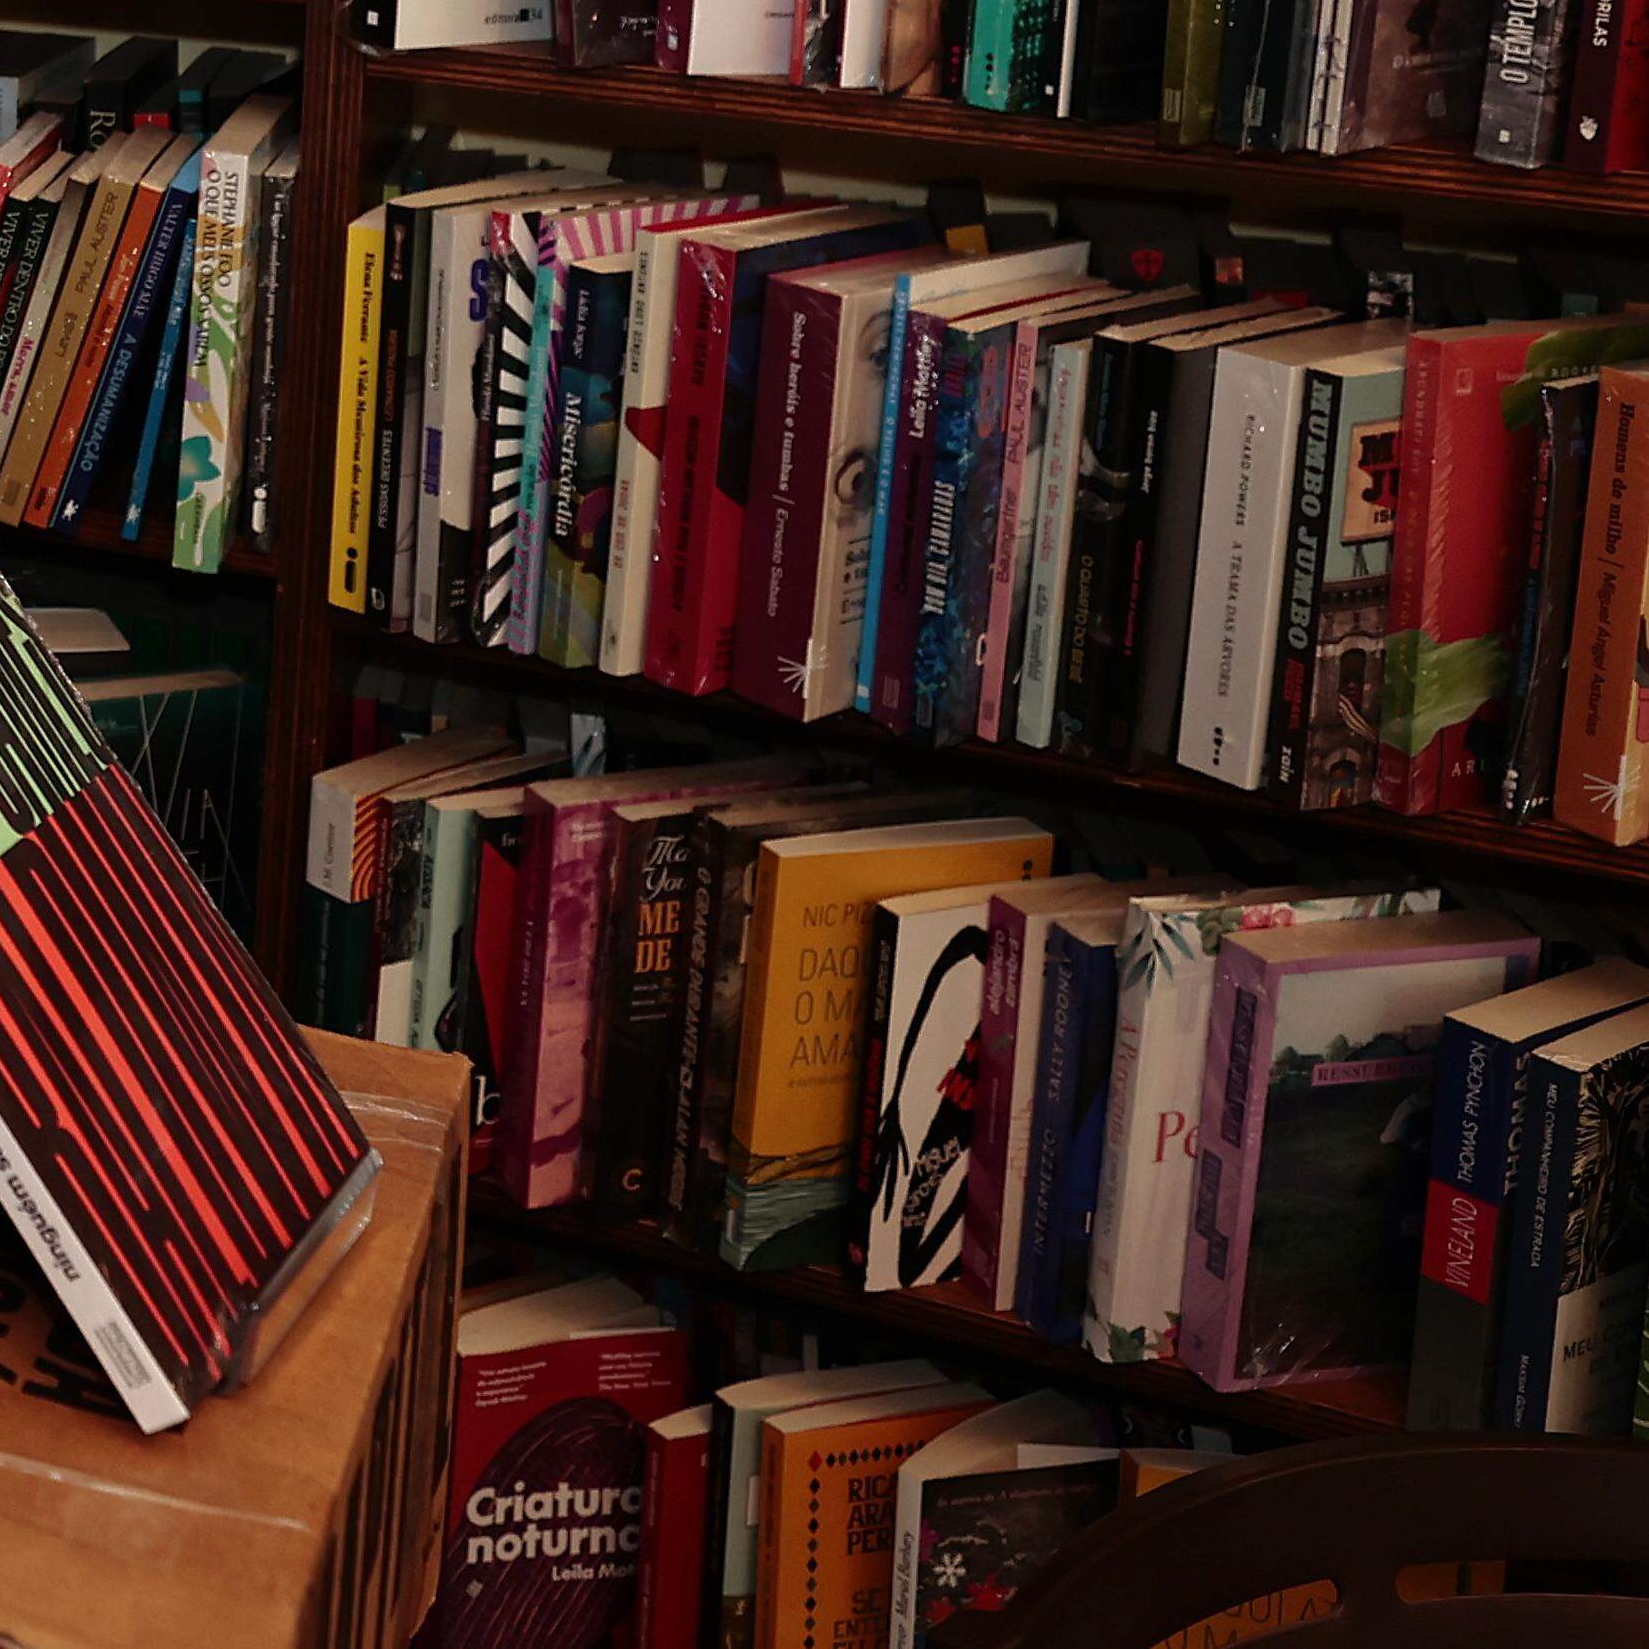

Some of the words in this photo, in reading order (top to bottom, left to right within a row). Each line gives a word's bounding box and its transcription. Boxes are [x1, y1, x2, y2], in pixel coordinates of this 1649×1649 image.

[21, 210, 50, 260] VIVER
[219, 170, 240, 252] STEPHANIE
[74, 254, 96, 297] PAUL
[92, 191, 120, 249] AUSTER
[216, 254, 232, 289] FOO
[2, 260, 35, 323] DENTRO
[789, 310, 807, 359] Sobre
[79, 348, 133, 474] DESUMANIZAÇÃO
[784, 361, 804, 415] heróis
[554, 391, 584, 537] Misericórdia
[778, 430, 796, 492] tumbas
[1300, 379, 1333, 519] MUMBO
[1614, 403, 1636, 475] Homens
[771, 507, 790, 565] Ernesto
[1604, 503, 1625, 555] milho
[1286, 526, 1326, 651] JUMBO
[1046, 1046, 1063, 1103] SALLY
[1463, 1040, 1487, 1116] PYNCHON
[1456, 1121, 1479, 1184] THOMAS
[7, 1173, 82, 1284] ninguém
[1443, 1196, 1478, 1288] VINELAND
[551, 1563, 595, 1584] Leila
